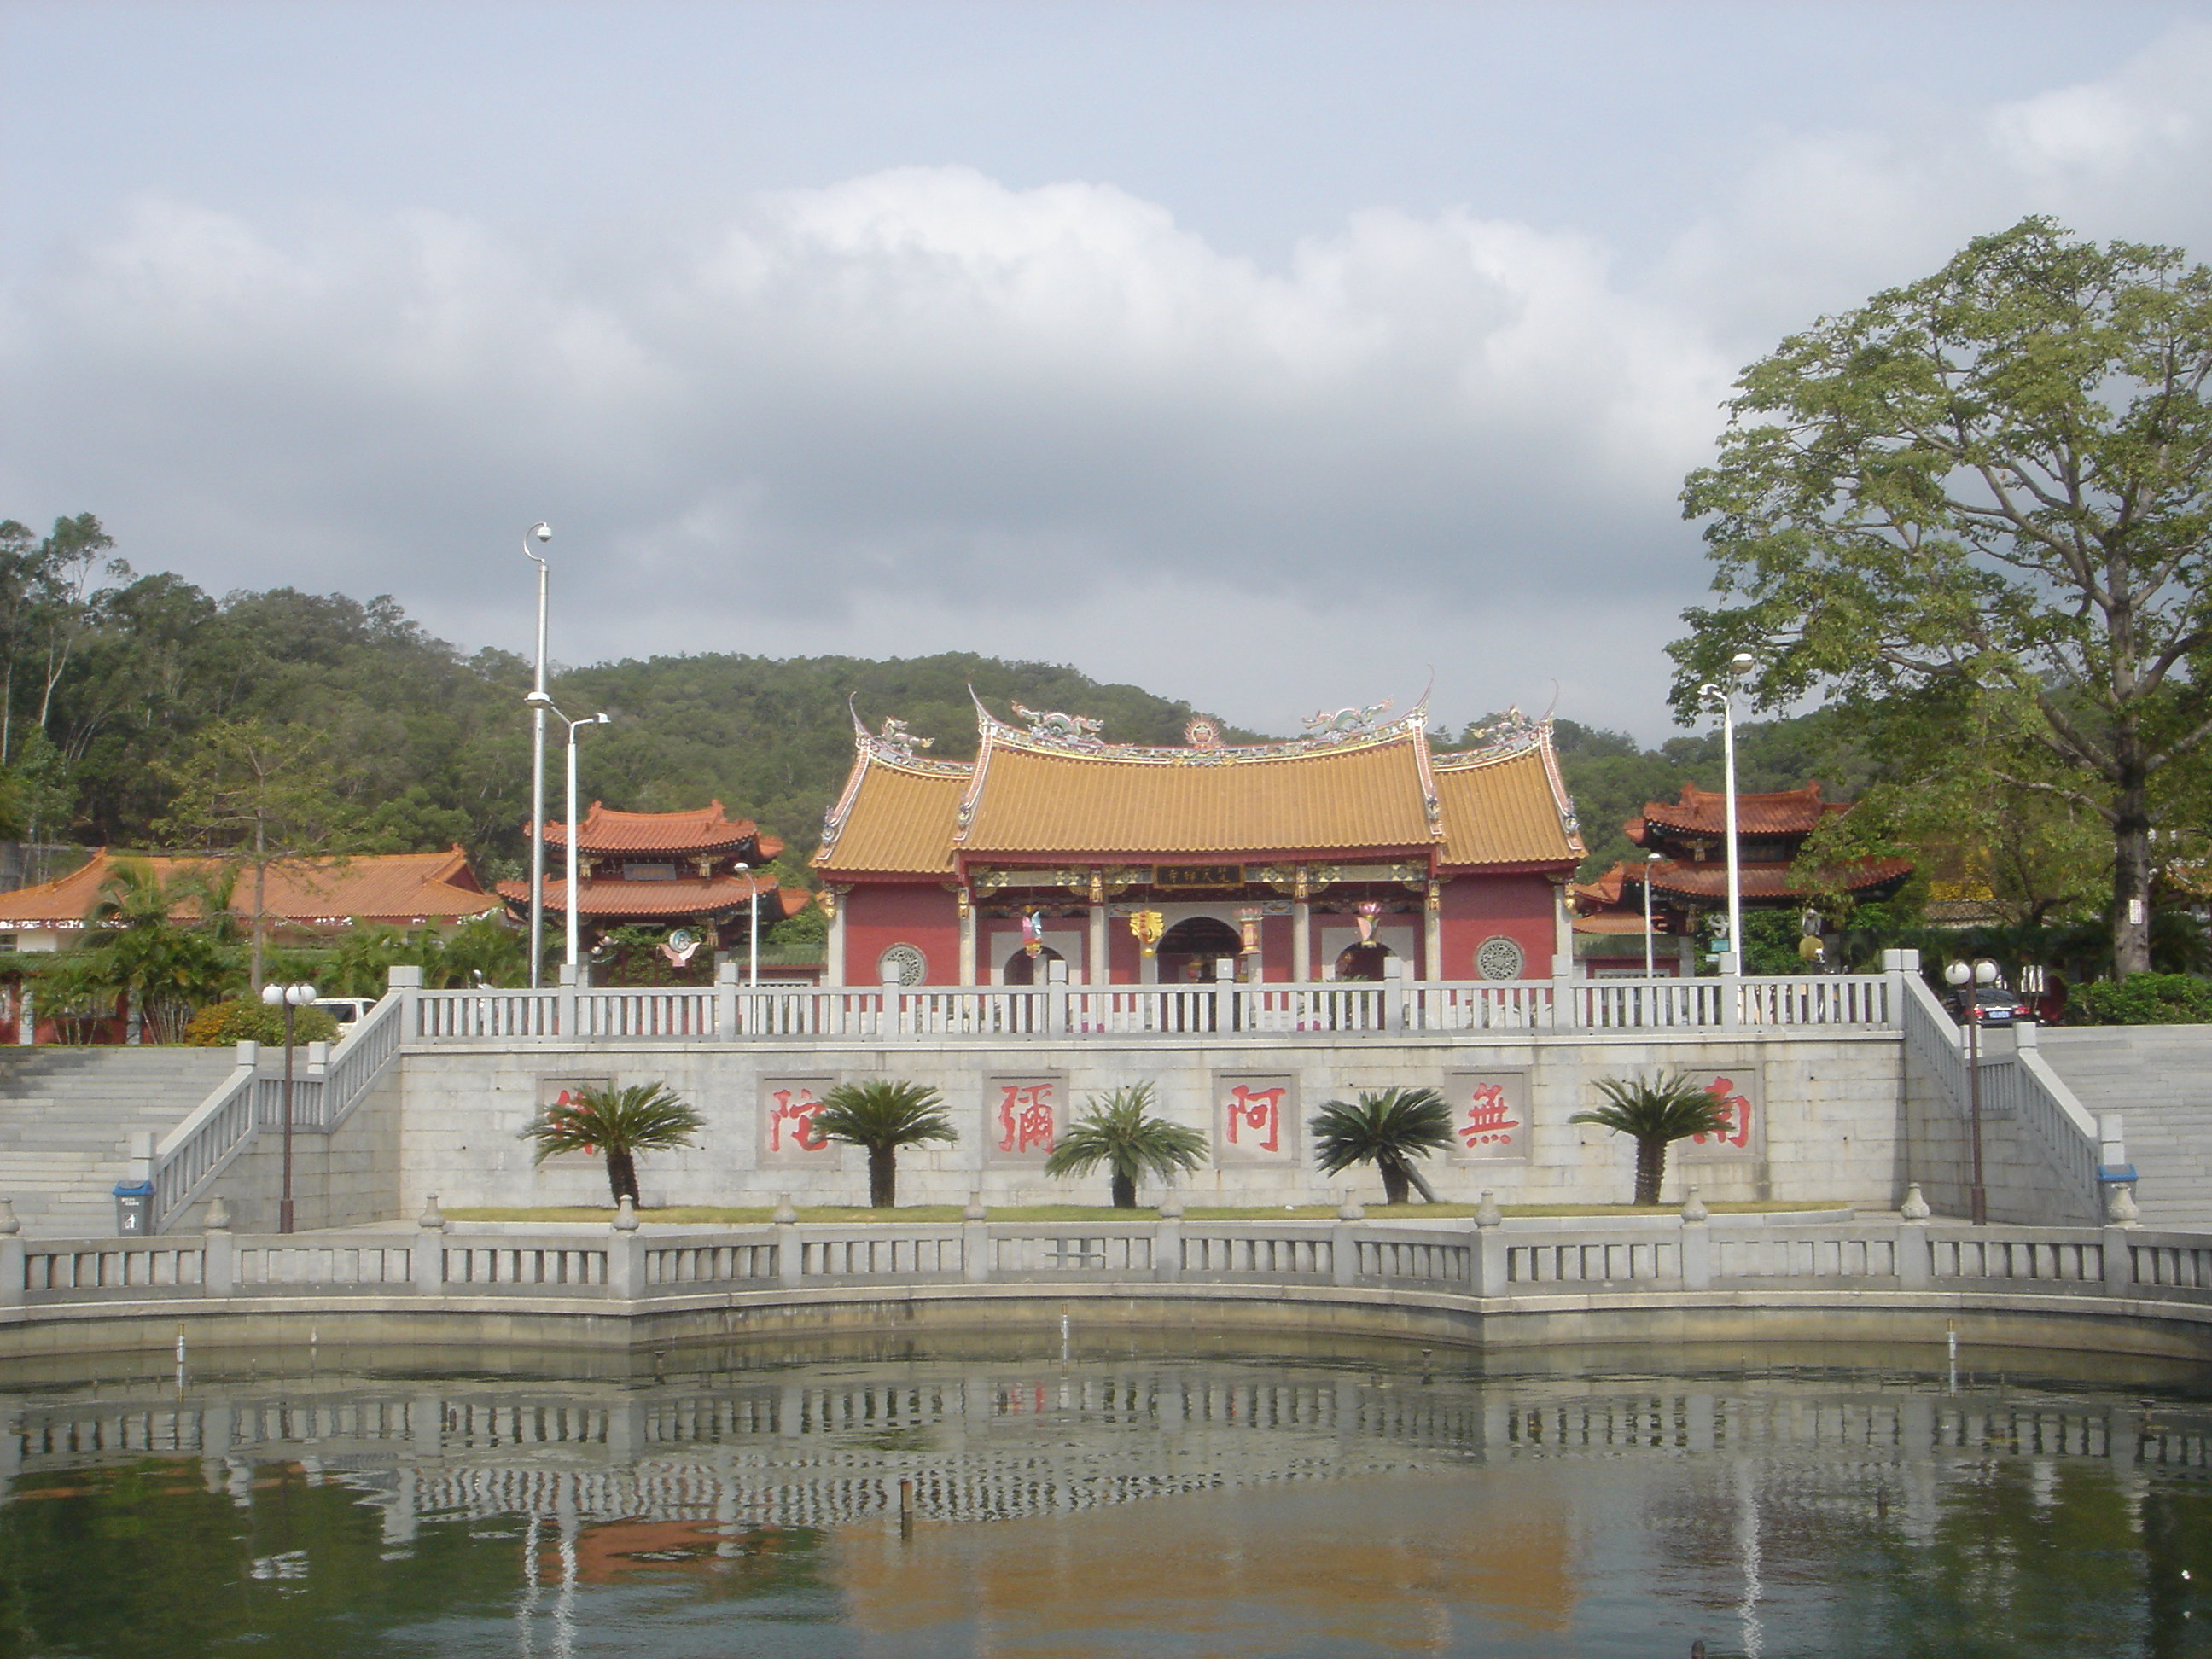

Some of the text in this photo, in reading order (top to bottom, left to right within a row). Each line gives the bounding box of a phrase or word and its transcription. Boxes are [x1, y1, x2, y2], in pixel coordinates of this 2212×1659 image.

[770, 1088, 829, 1152] 陀
[998, 1083, 1054, 1155] 彌
[1227, 1084, 1286, 1152] 阿
[1458, 1082, 1518, 1148] 無
